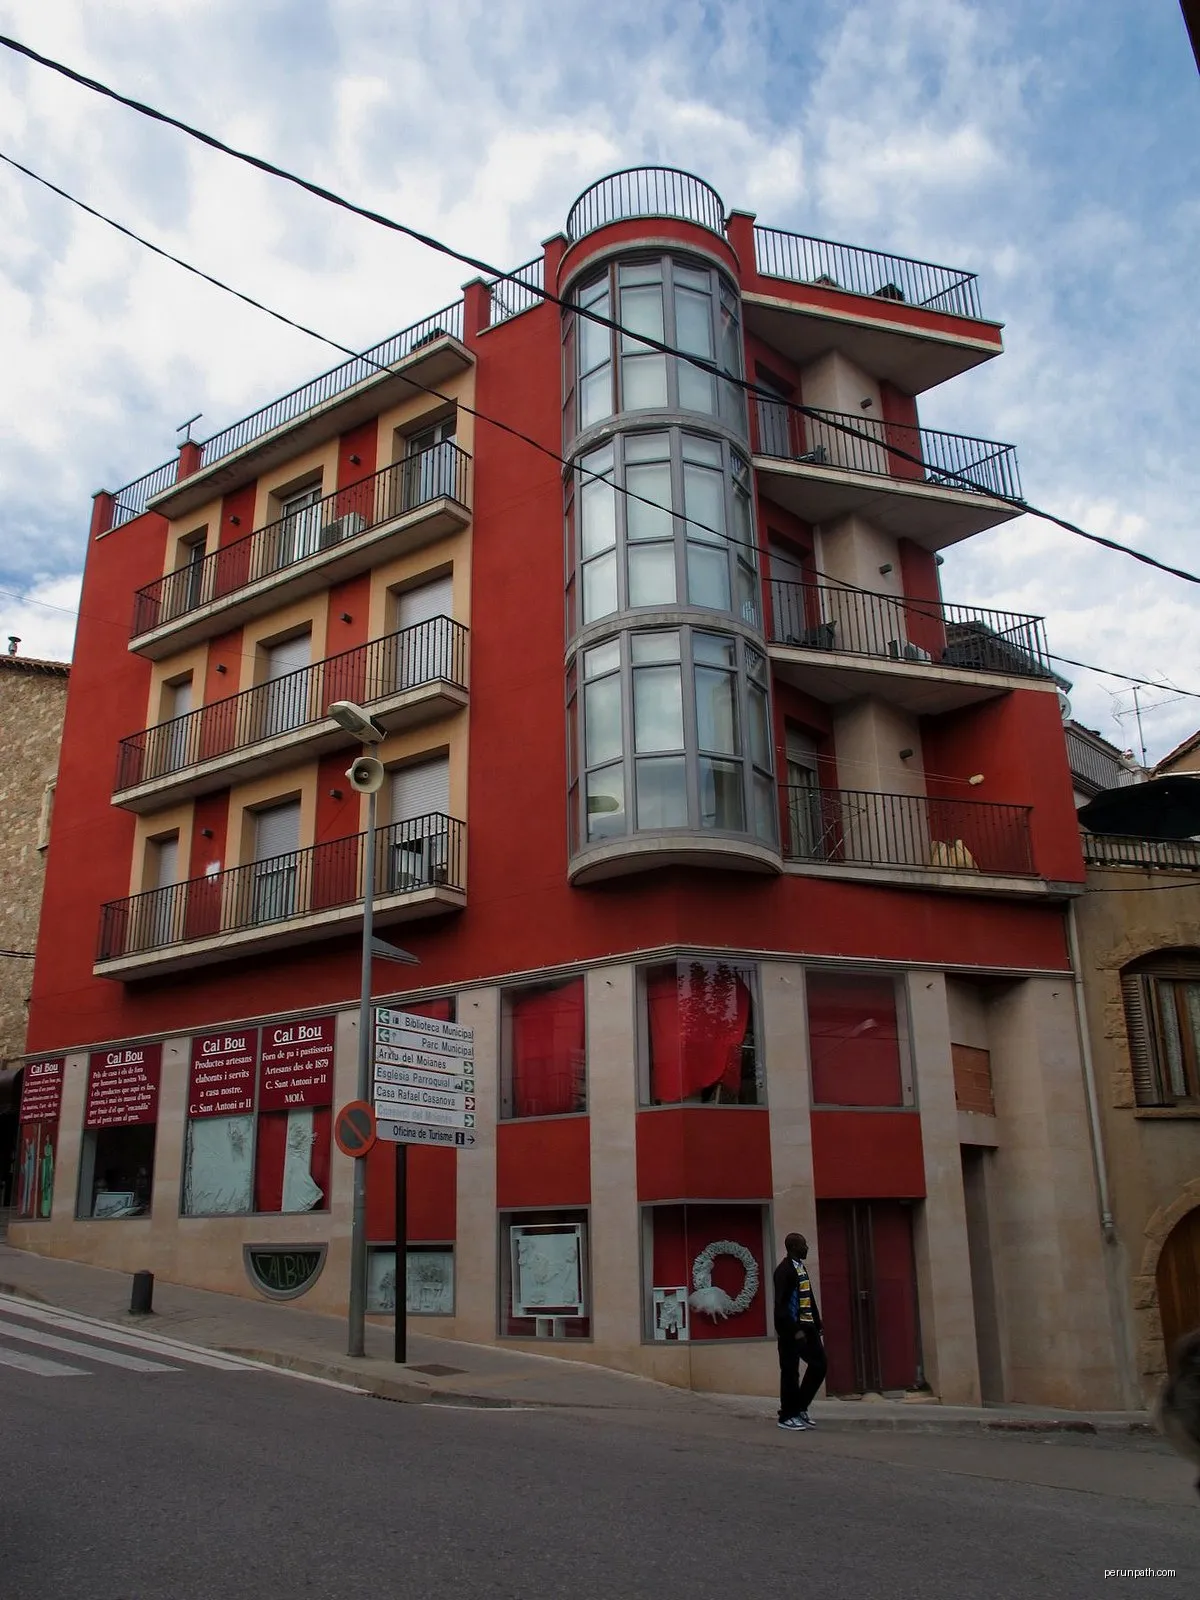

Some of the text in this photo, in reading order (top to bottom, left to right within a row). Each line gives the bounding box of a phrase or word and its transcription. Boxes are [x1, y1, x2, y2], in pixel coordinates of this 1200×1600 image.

[274, 1026, 321, 1042] Cal Bou
[405, 1017, 474, 1039] Biblioteca Municipal
[203, 1037, 245, 1053] Cal Bou
[263, 1052, 276, 1061] Forn
[277, 1051, 285, 1059] de
[287, 1051, 294, 1059] pa
[301, 1044, 333, 1057] pastisseria
[422, 1038, 474, 1056] Parc Municipal
[107, 1051, 143, 1064] Cal Bou
[195, 1056, 252, 1070] Productes artesans
[379, 1049, 398, 1060] Arxiu
[403, 1052, 413, 1062] del
[31, 1063, 58, 1074] Cal Bou
[265, 1059, 329, 1075] Artesans des de 1879
[196, 1069, 249, 1084] elaborats i servits
[266, 1081, 273, 1089] C.
[275, 1080, 288, 1088] Sant
[290, 1076, 312, 1086] Antoni
[413, 1073, 450, 1088] Parroquial
[377, 1086, 455, 1106] Casa Rafael Casanova
[190, 1104, 198, 1113] C.
[199, 1104, 213, 1112] Sant
[215, 1101, 237, 1111] Antoni
[393, 1126, 452, 1141] Oficina de Turisme
